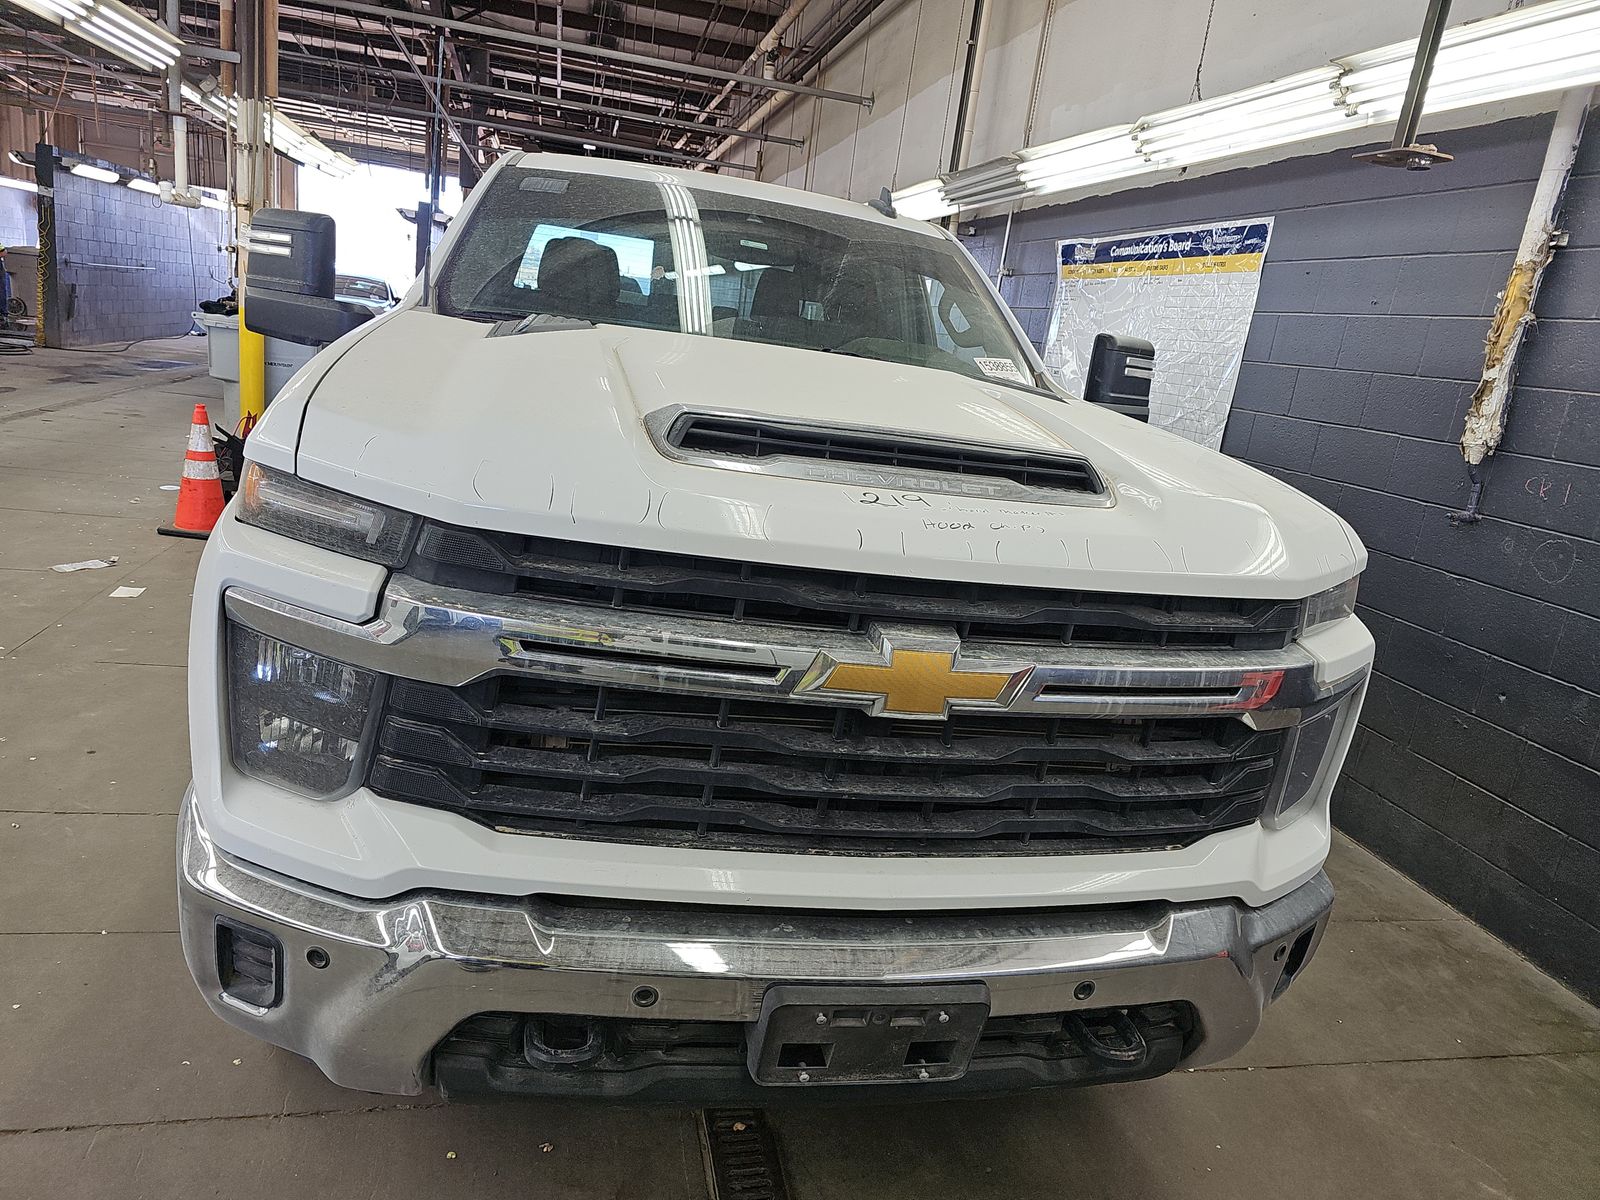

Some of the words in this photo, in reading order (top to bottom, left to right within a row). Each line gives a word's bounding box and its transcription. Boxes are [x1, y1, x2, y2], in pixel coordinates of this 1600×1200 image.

[1110, 241, 1167, 256] Communication's
[1169, 238, 1192, 252] Board
[807, 466, 1002, 495] CHEVROLET
